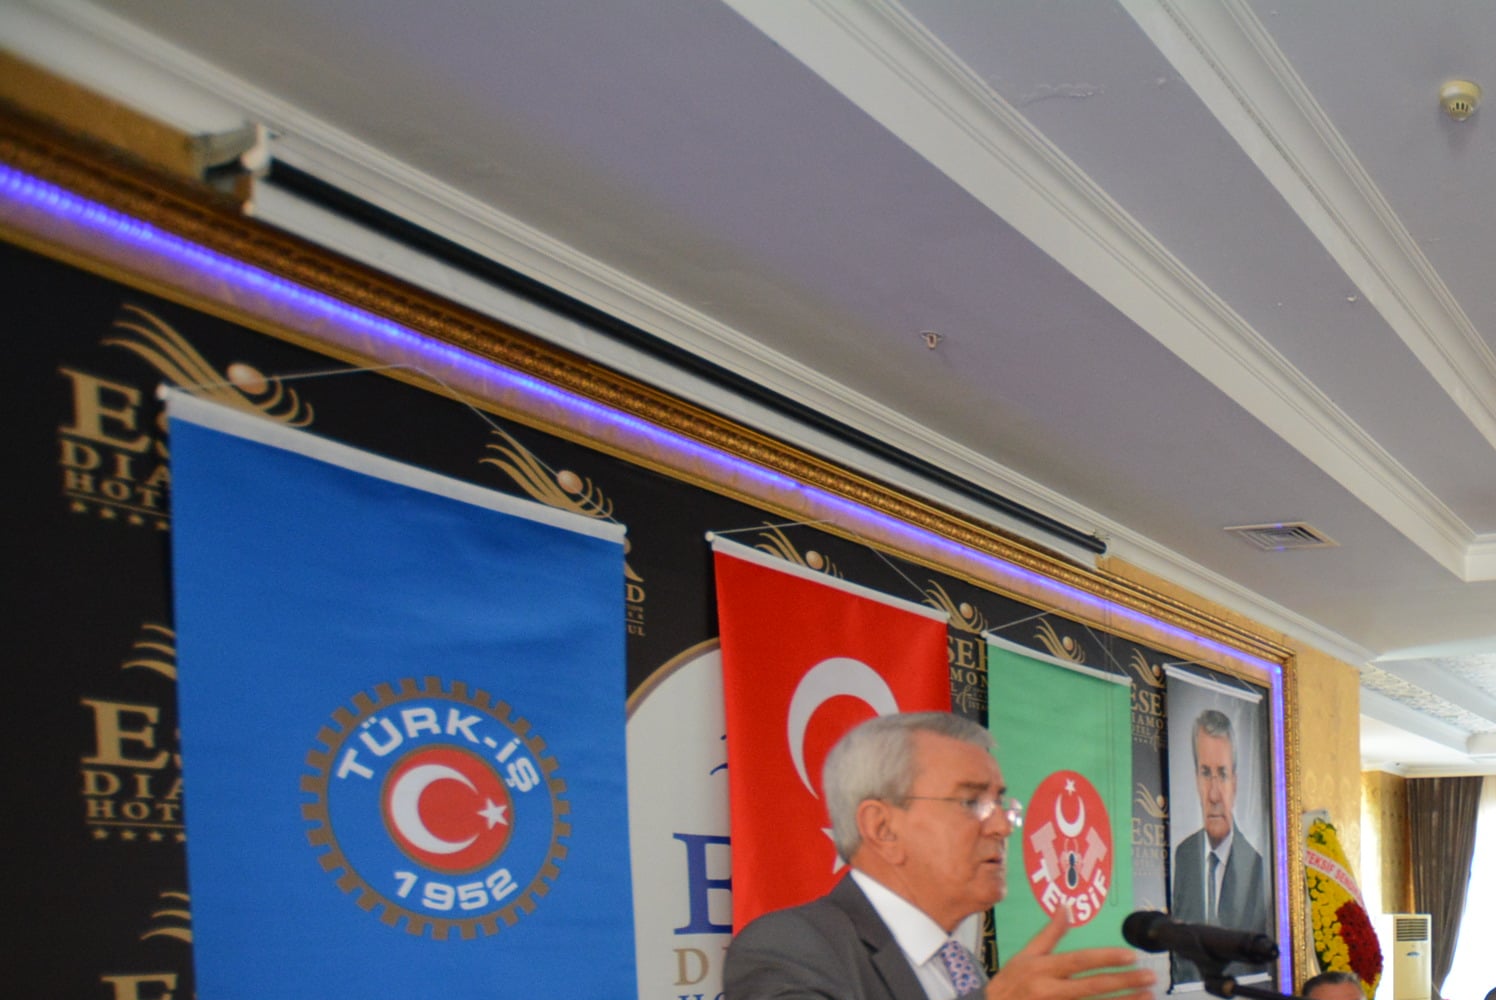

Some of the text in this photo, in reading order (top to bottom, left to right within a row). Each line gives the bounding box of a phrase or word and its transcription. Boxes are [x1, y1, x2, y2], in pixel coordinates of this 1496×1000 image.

[64, 469, 163, 508] HOT
[336, 707, 540, 793] TÜRK-İŞ
[86, 799, 181, 822] HOT
[394, 867, 518, 912] 1952
